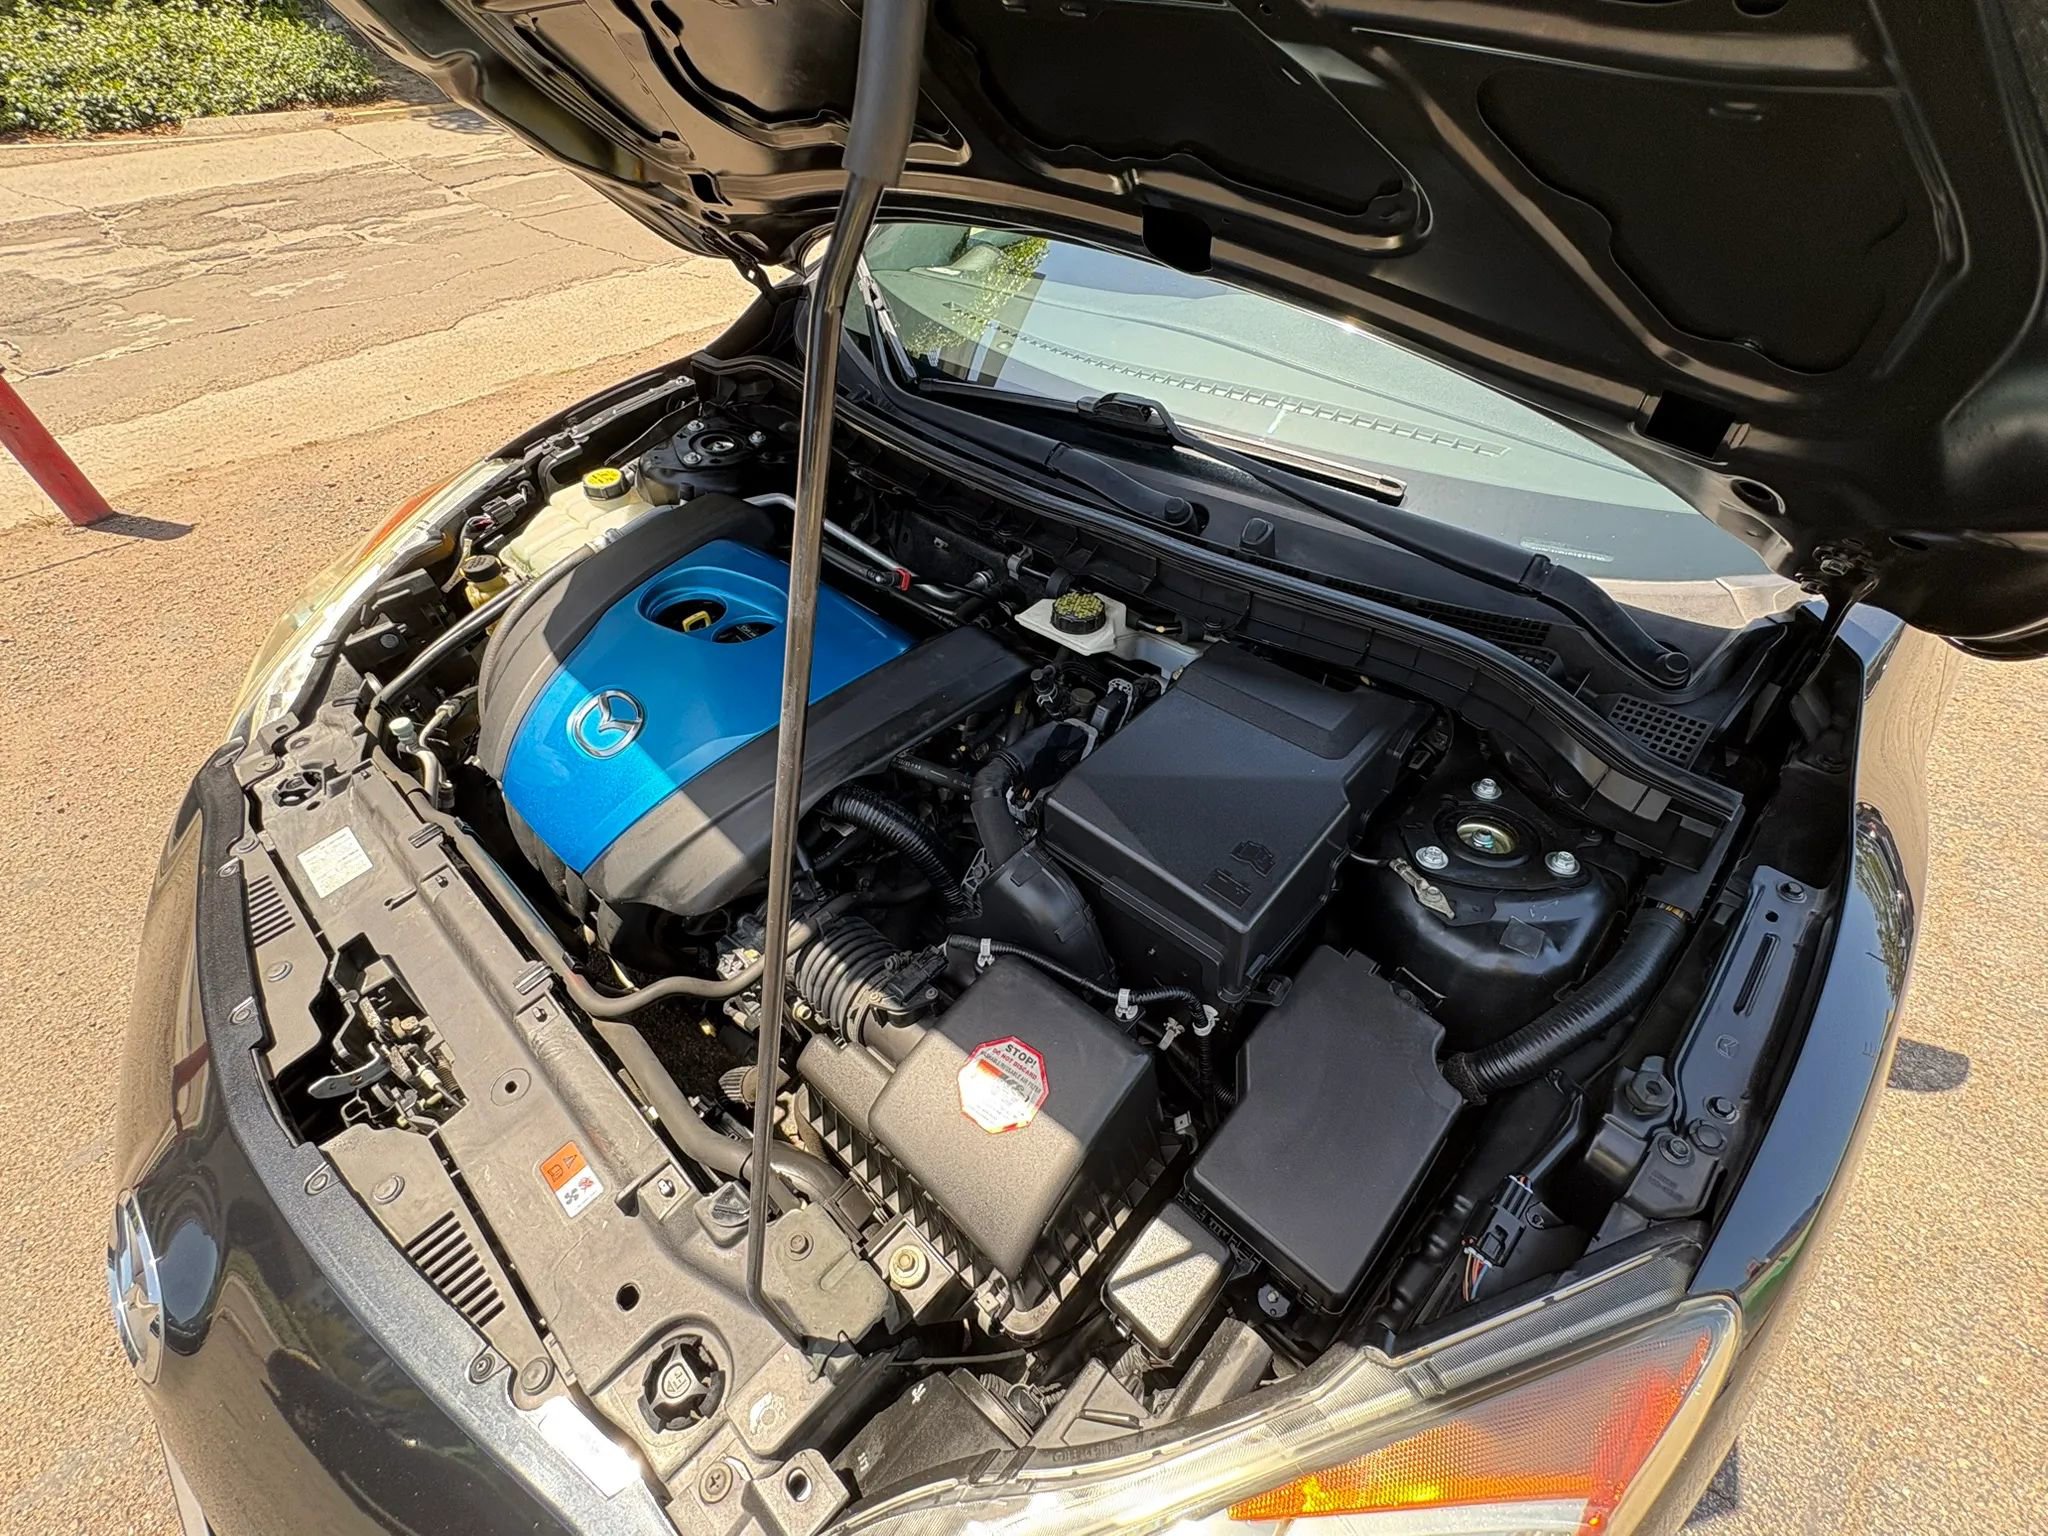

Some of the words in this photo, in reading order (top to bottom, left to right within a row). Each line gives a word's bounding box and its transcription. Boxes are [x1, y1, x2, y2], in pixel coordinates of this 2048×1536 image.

[992, 1047, 1001, 1056] DO
[1001, 1053, 1014, 1063] NOT
[1013, 1060, 1038, 1080] DISCARD
[1005, 1043, 1037, 1069] STOP!
